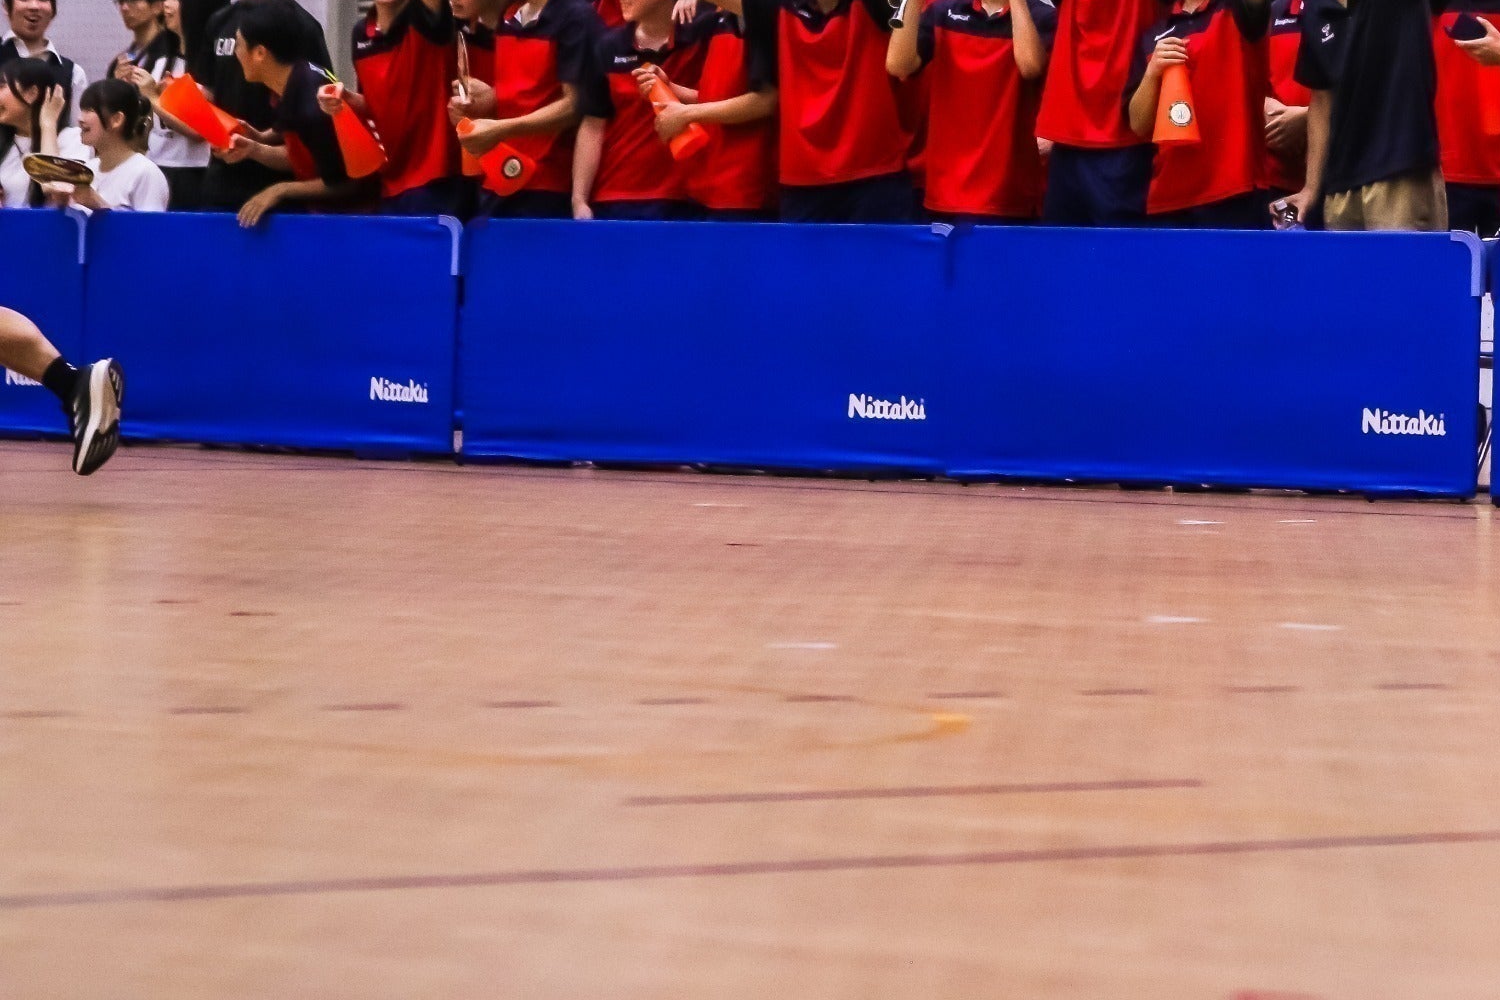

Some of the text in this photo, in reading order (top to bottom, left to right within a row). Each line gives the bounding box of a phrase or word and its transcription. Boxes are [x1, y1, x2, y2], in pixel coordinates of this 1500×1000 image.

[369, 376, 429, 403] Nittaku
[847, 393, 926, 420] Nittaku
[1361, 407, 1447, 436] Nittaku
